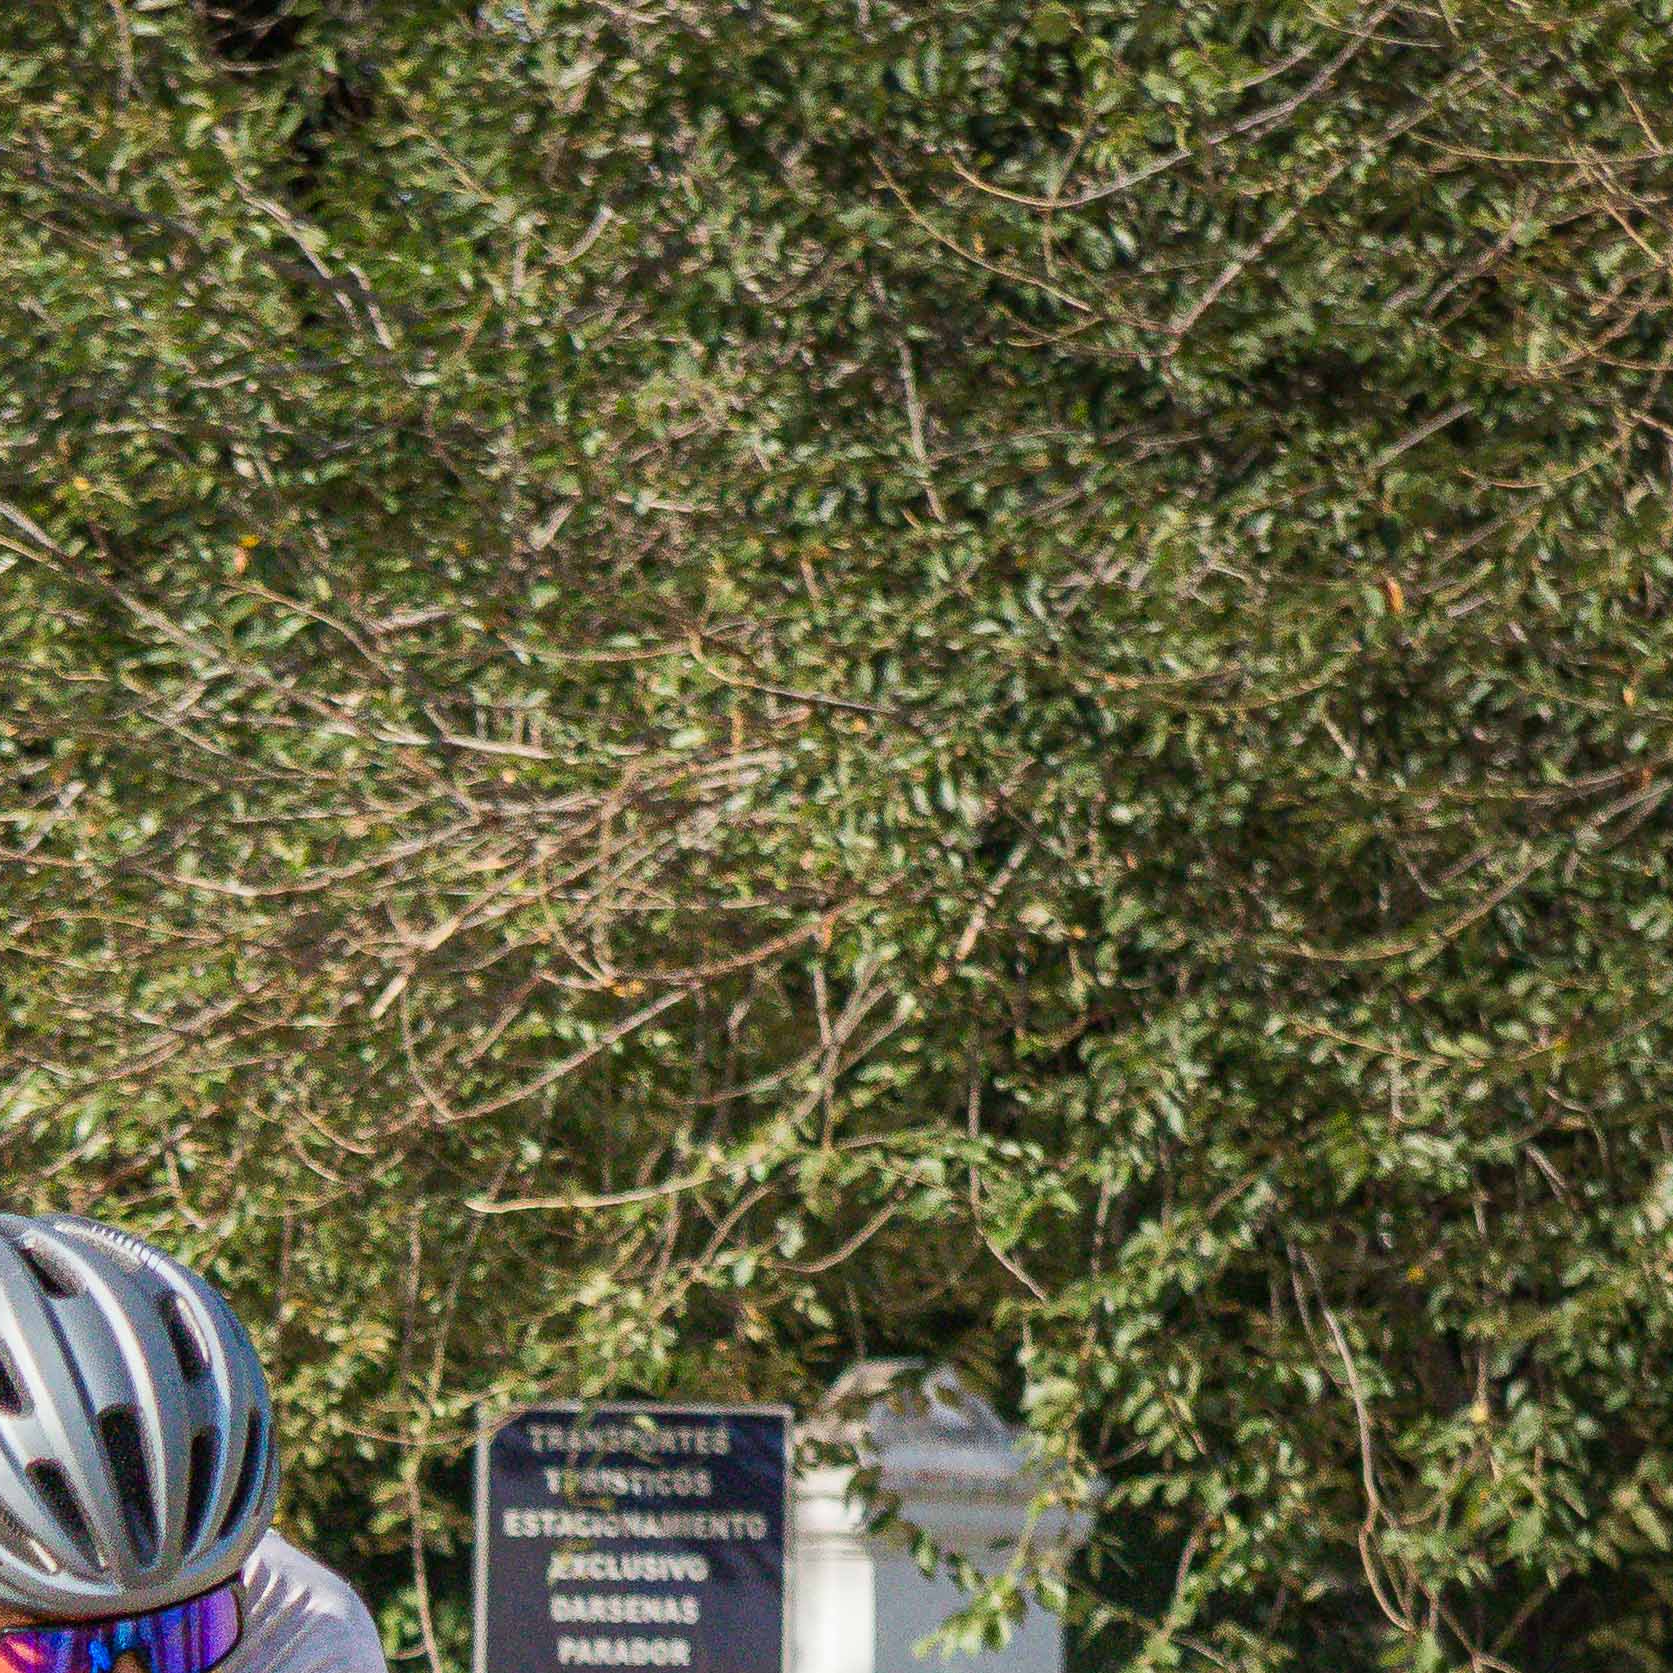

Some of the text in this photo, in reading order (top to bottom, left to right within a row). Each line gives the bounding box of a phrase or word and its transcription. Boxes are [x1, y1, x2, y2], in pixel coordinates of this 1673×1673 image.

[503, 1508, 767, 1539] ESTACIONAMIENTO
[550, 1594, 700, 1624] DARSENAS
[557, 1637, 691, 1665] PARADOR
